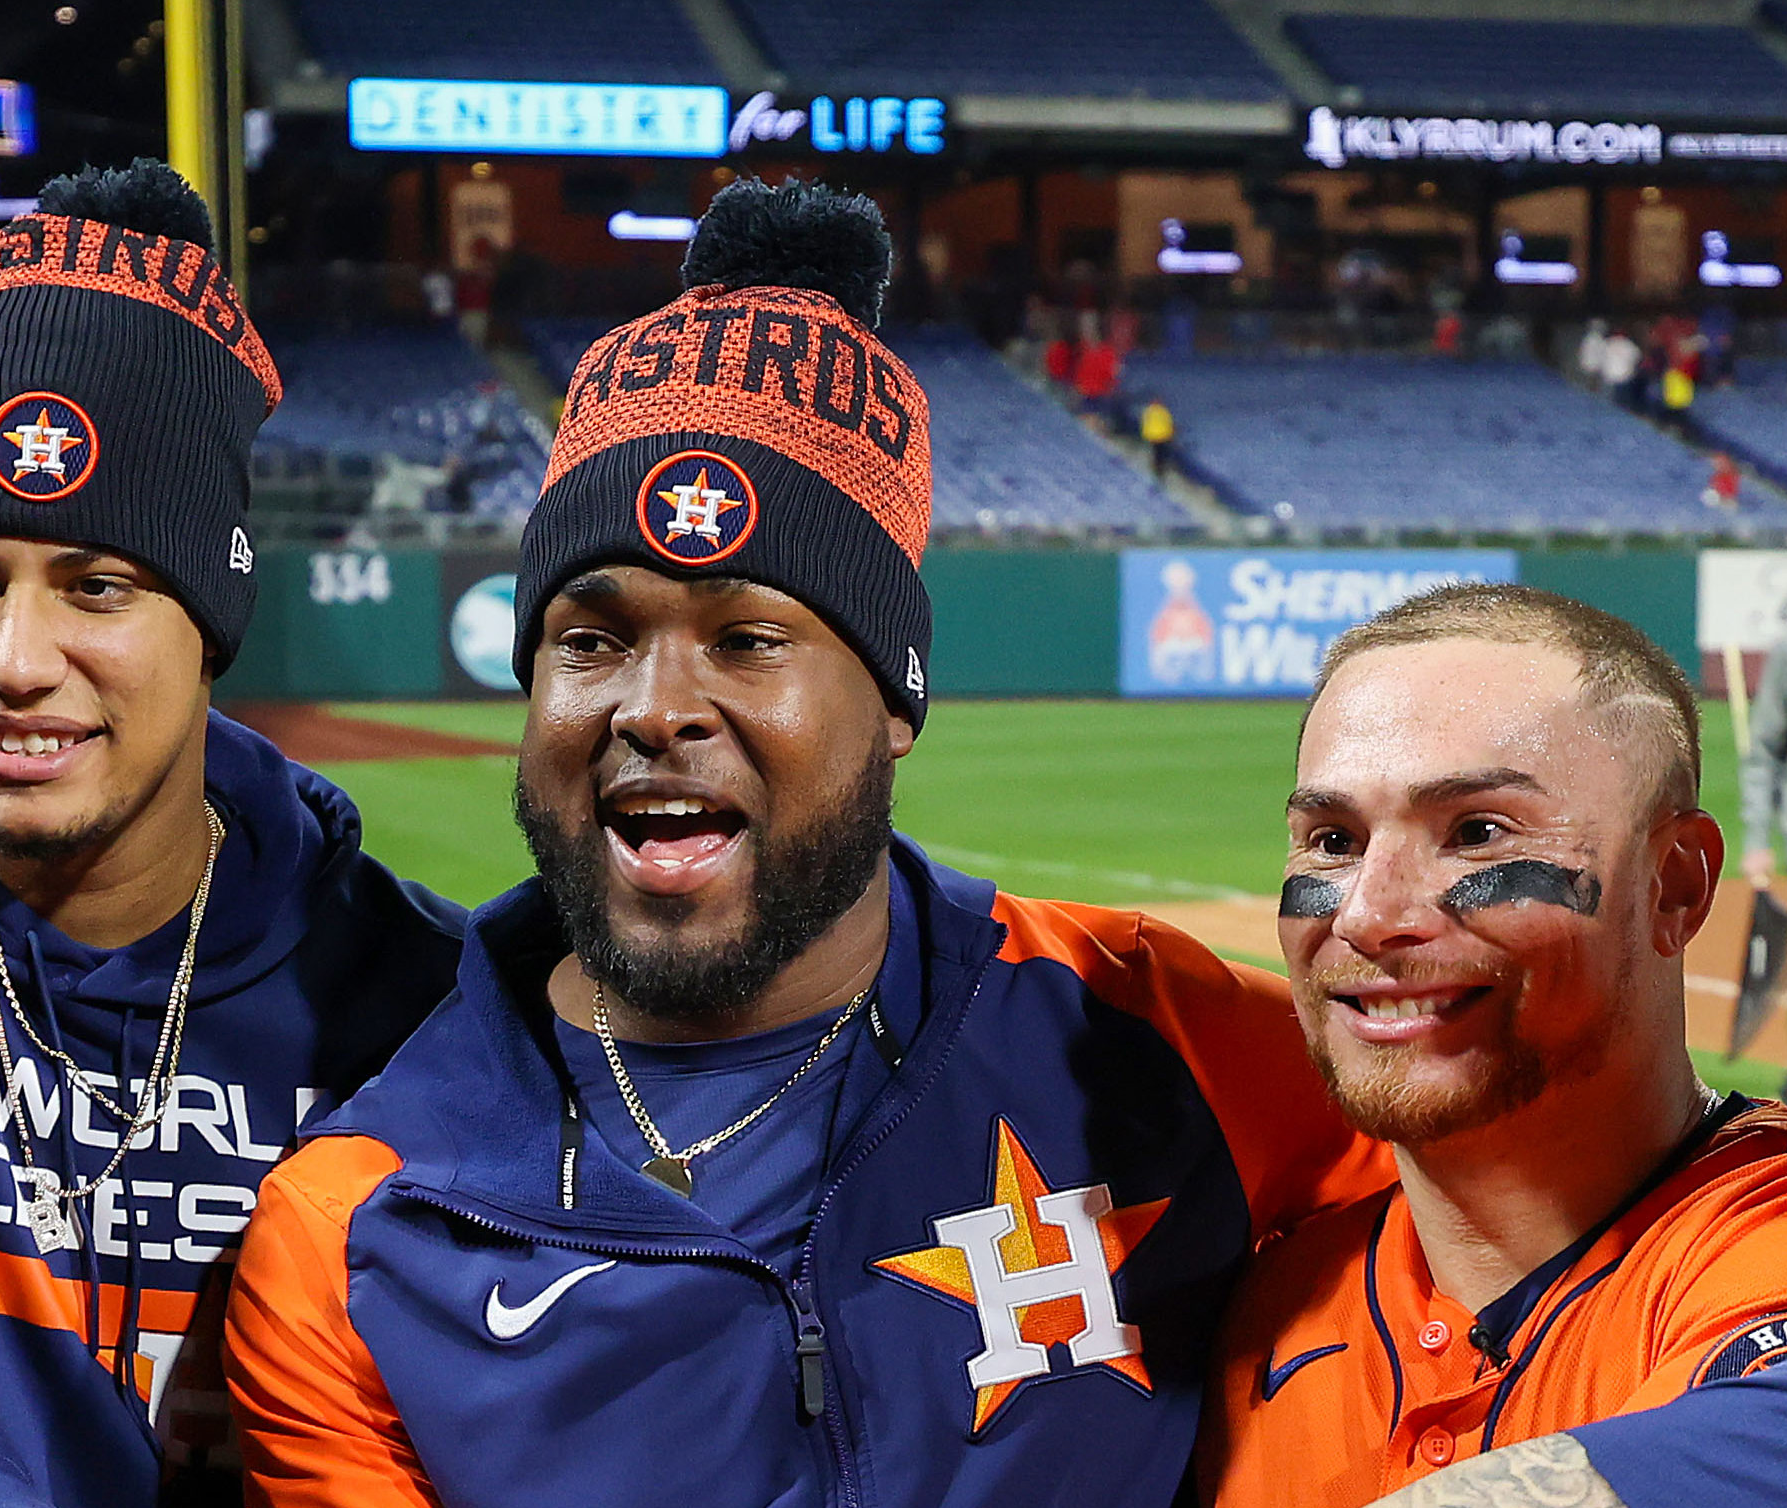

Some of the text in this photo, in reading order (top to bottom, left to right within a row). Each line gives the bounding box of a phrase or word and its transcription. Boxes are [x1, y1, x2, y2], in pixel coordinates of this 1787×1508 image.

[363, 90, 701, 141] DENTISTRY
[810, 95, 947, 154] LIFE
[571, 305, 912, 460] ASTROS
[13, 424, 69, 474] H
[667, 484, 727, 538] H
[933, 1183, 1145, 1391] H
